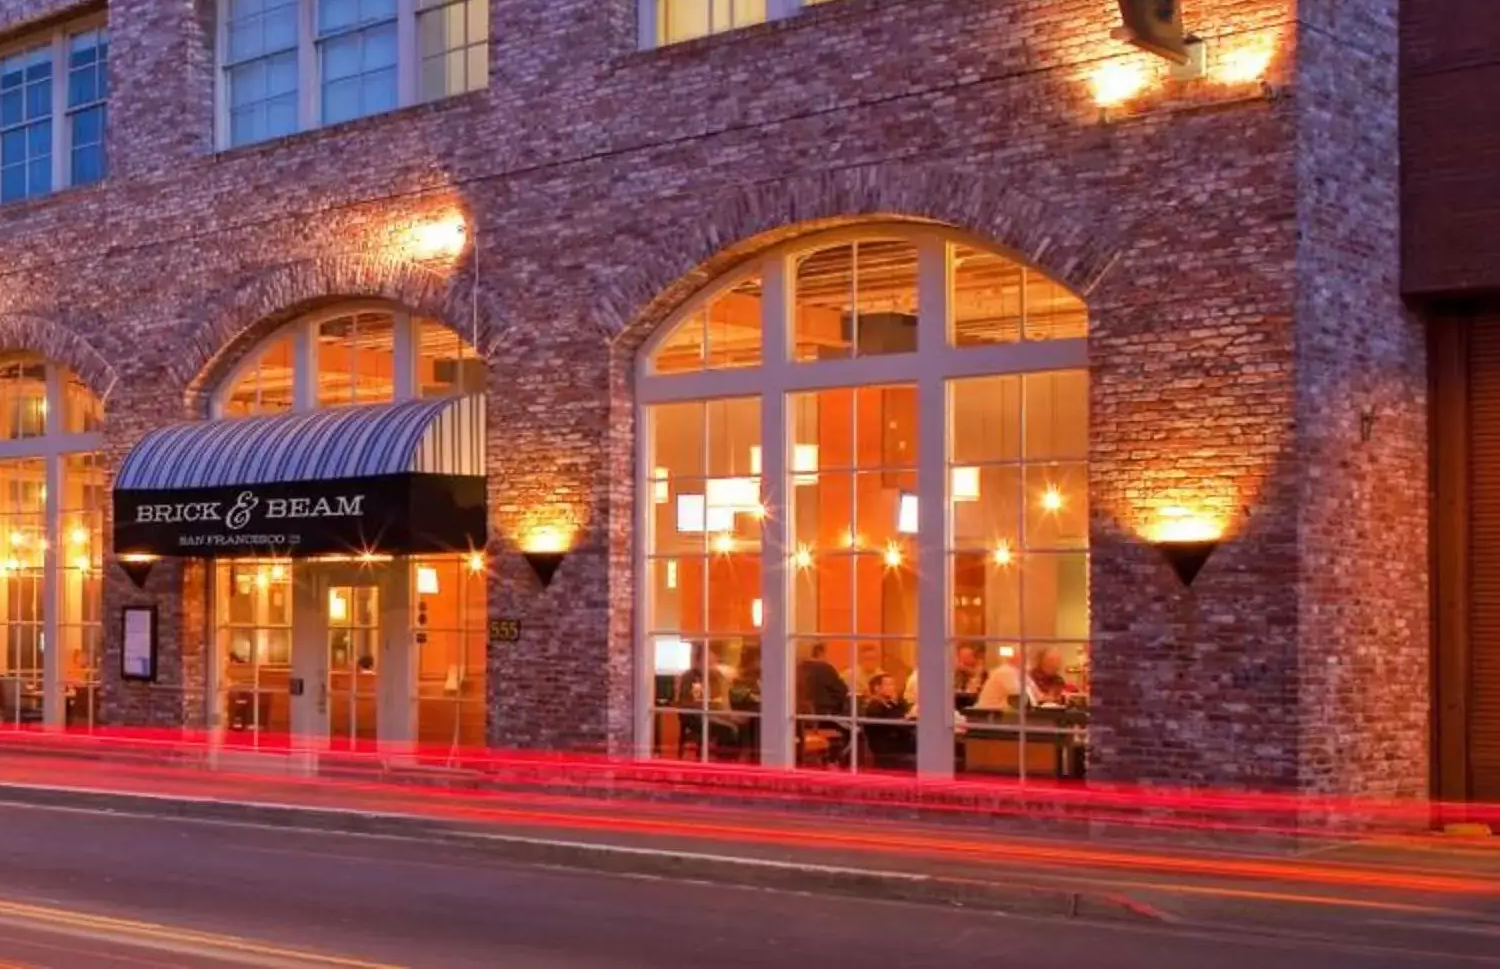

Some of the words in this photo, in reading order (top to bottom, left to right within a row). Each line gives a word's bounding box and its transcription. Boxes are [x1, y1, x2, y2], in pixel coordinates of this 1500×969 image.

[135, 502, 222, 523] BRICK
[226, 490, 259, 530] &
[265, 494, 365, 519] BEAM
[179, 534, 204, 546] SAN
[205, 533, 285, 545] FRANCISCO
[491, 621, 518, 639] 555
